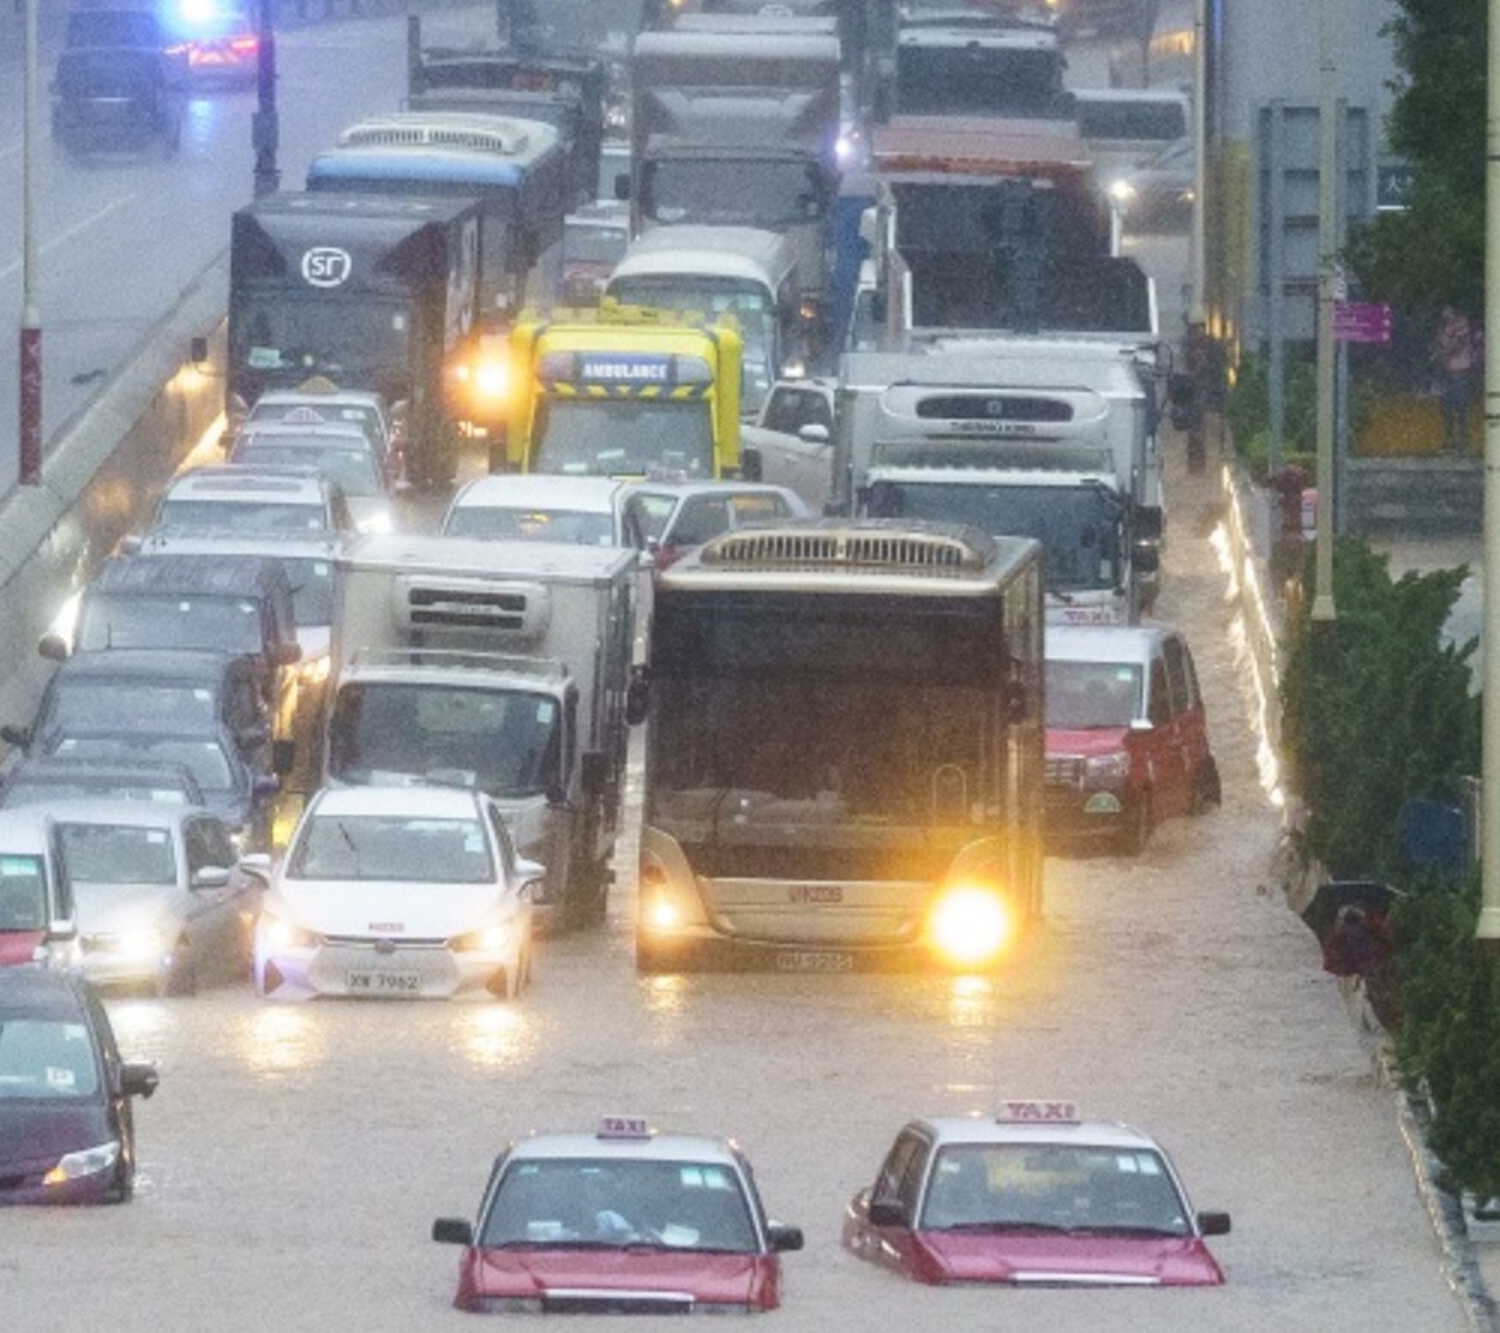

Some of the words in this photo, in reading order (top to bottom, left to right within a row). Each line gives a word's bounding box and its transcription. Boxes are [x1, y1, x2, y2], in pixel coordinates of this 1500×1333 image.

[581, 363, 668, 379] AMBULANCE
[1004, 1102, 1075, 1120] TAXI
[603, 1118, 647, 1134] TAXI
